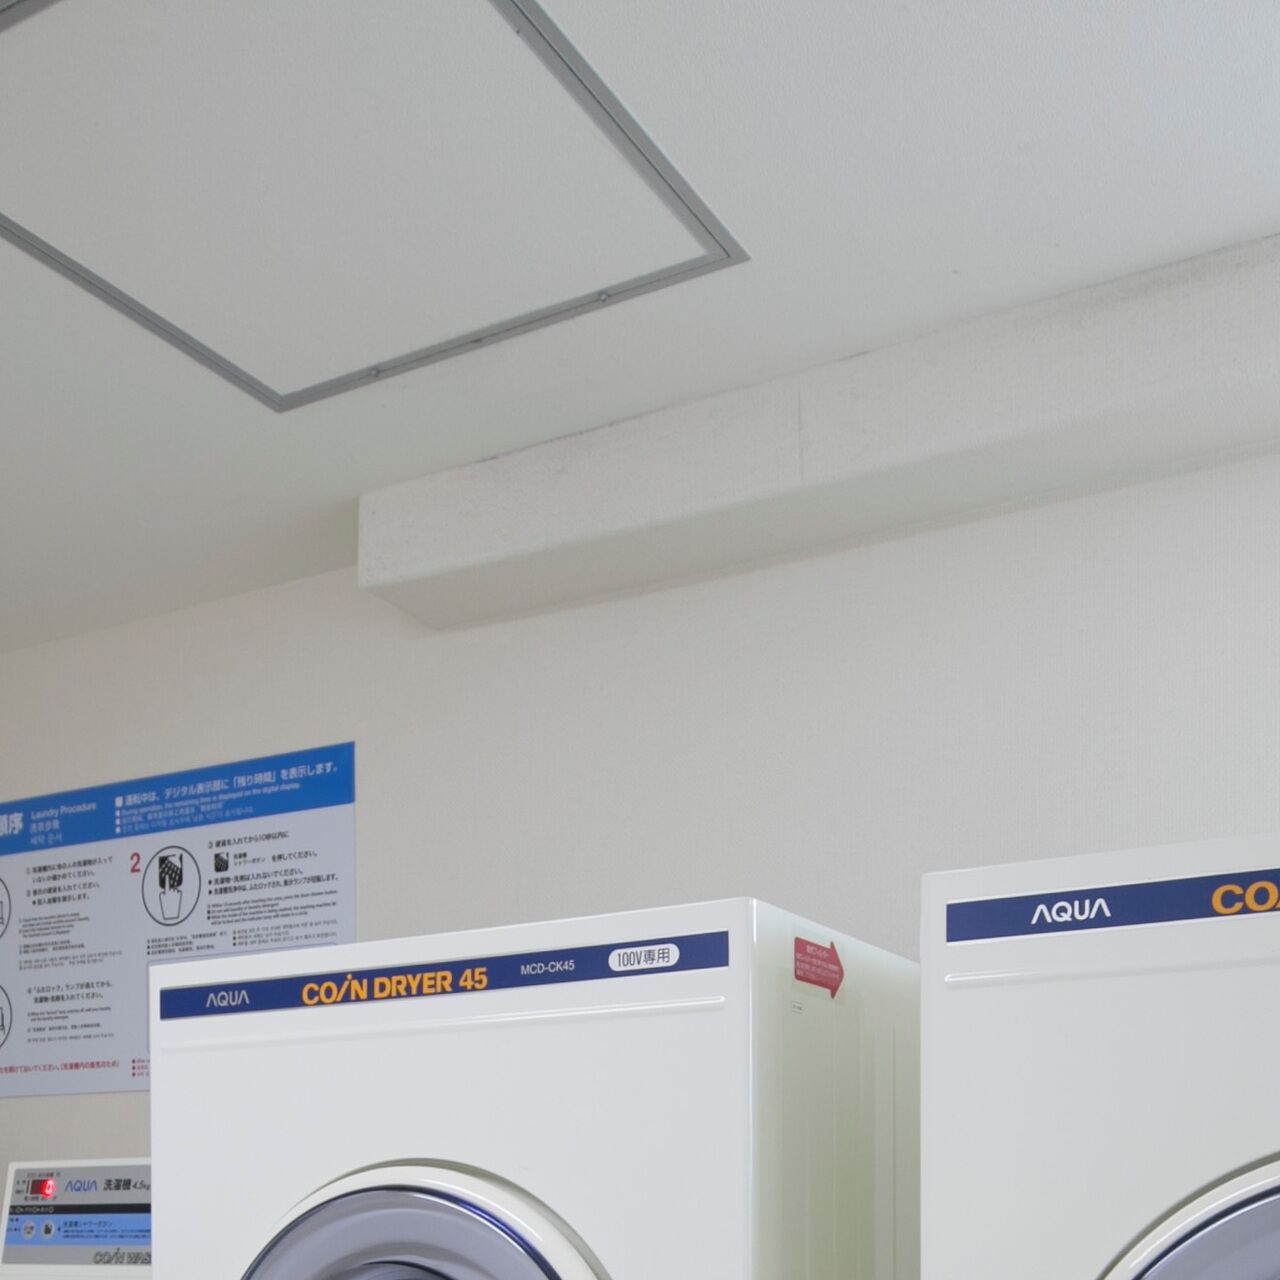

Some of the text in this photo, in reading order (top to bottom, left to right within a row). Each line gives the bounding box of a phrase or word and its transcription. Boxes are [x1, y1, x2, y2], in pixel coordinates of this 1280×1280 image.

[30, 802, 97, 820] Laundry Procedure
[130, 852, 140, 873] 2
[1031, 897, 1111, 925] AQUA
[617, 948, 670, 968] 100V専用
[206, 989, 250, 1008] AQUA
[373, 971, 453, 999] DRYER
[458, 967, 488, 990] 45
[521, 960, 575, 975] MCD-CK45
[65, 1180, 97, 1192] AQUA
